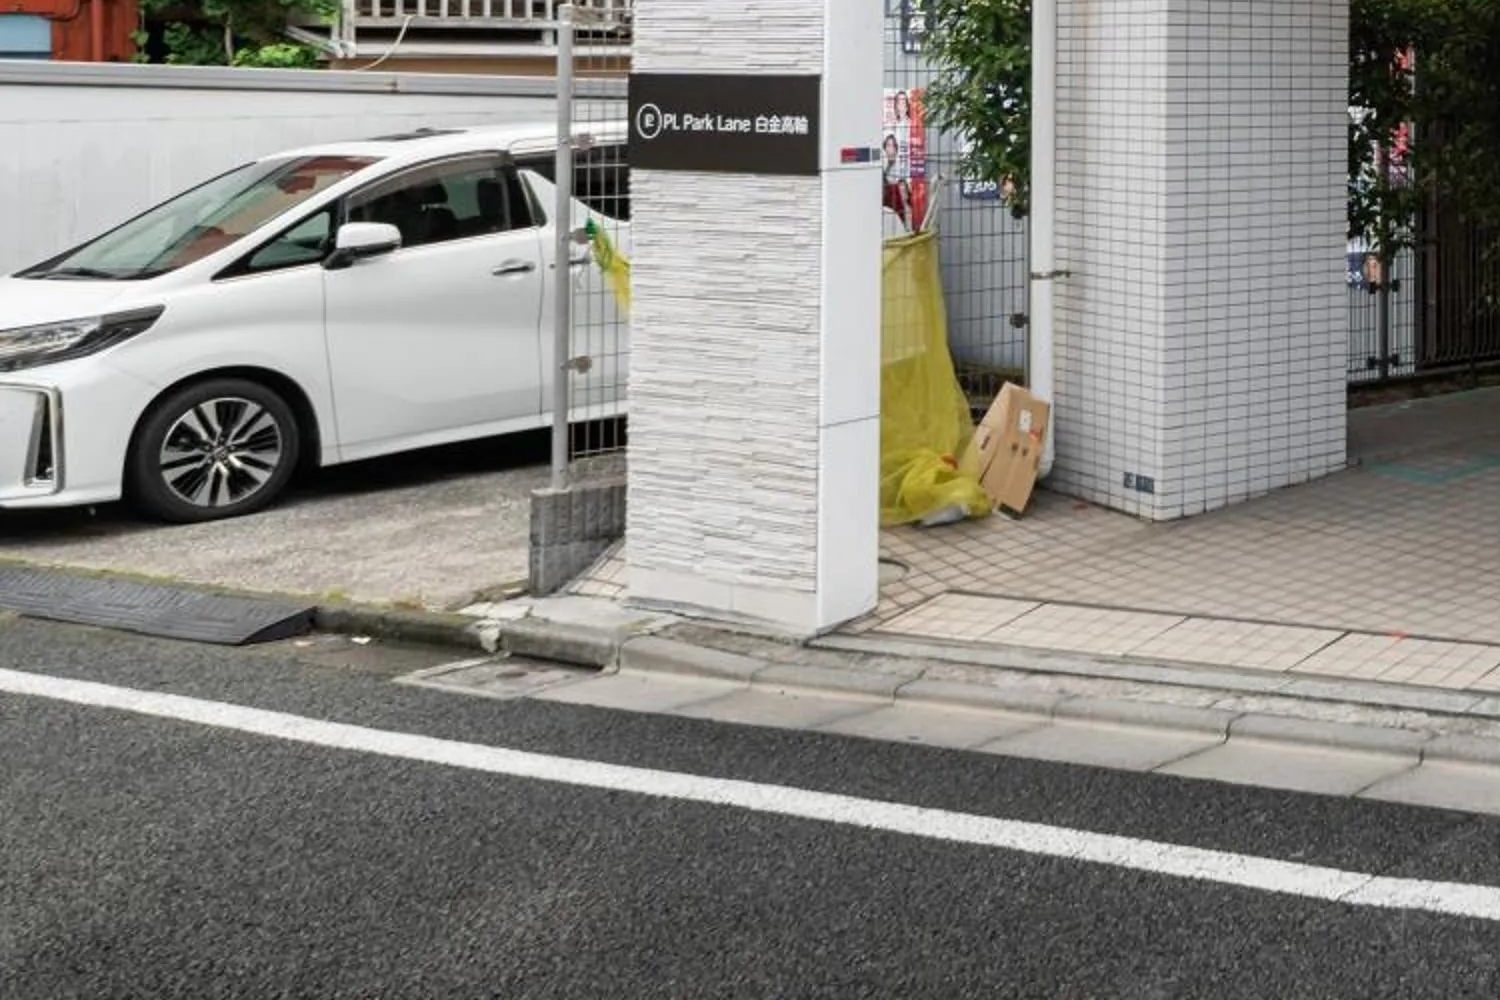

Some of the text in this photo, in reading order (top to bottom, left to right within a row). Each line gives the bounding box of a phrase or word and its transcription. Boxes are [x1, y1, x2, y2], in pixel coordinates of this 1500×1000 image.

[663, 114, 680, 131] PL
[683, 114, 713, 131] Park
[717, 115, 751, 132] Lane
[755, 116, 809, 135] 白金高輪
